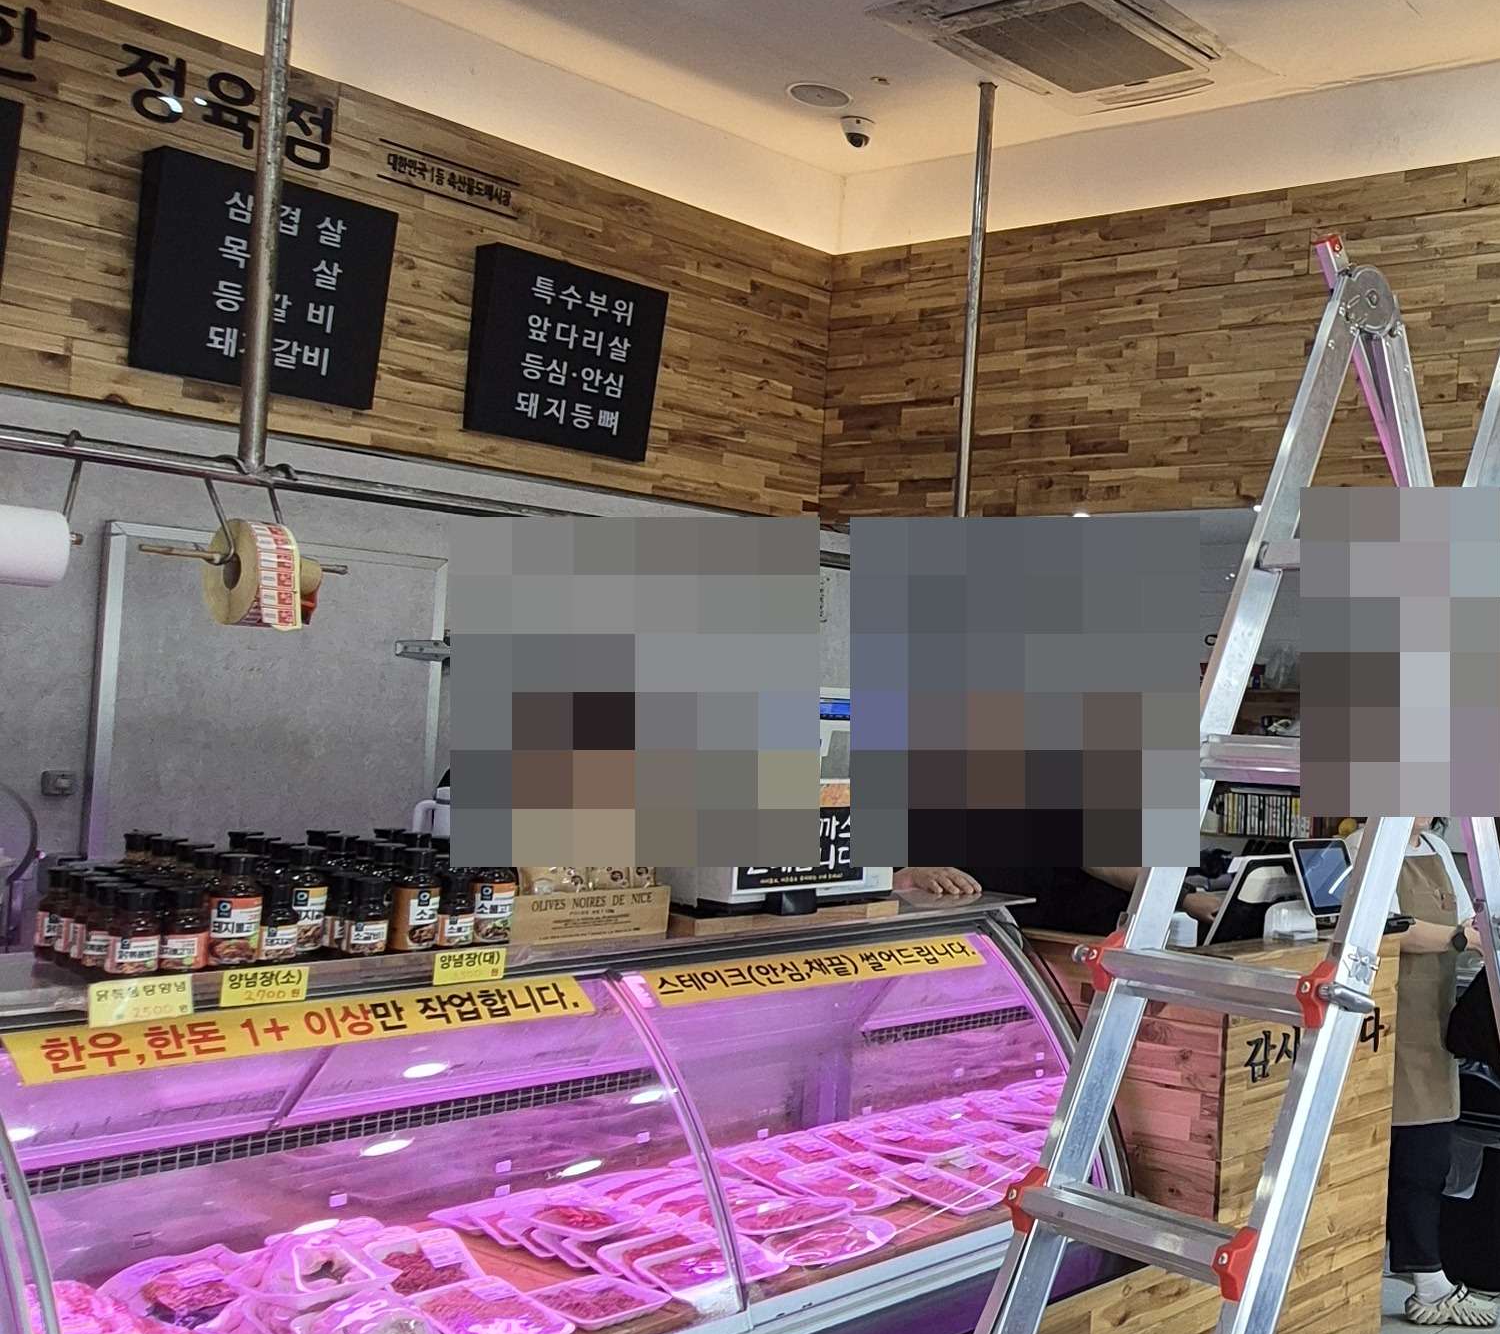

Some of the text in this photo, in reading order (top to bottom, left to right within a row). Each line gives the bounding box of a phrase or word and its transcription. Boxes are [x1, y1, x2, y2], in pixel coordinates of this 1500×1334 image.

[116, 43, 334, 171] 정육점
[531, 275, 634, 327] 특수부위
[206, 325, 330, 376] 돼갈비
[527, 314, 632, 363] 앞다리살
[514, 392, 620, 436] 돼지등뼈
[531, 892, 653, 912] OLIVES NOIRES DE NICE
[228, 969, 303, 989] 양념장(소)
[440, 951, 501, 970] 양념장(대)
[657, 941, 977, 995] 스테이크(안심,채끝) 썰어드립니다.
[40, 982, 580, 1074] 한우,한돈 1+ 이상만 작업합니다.
